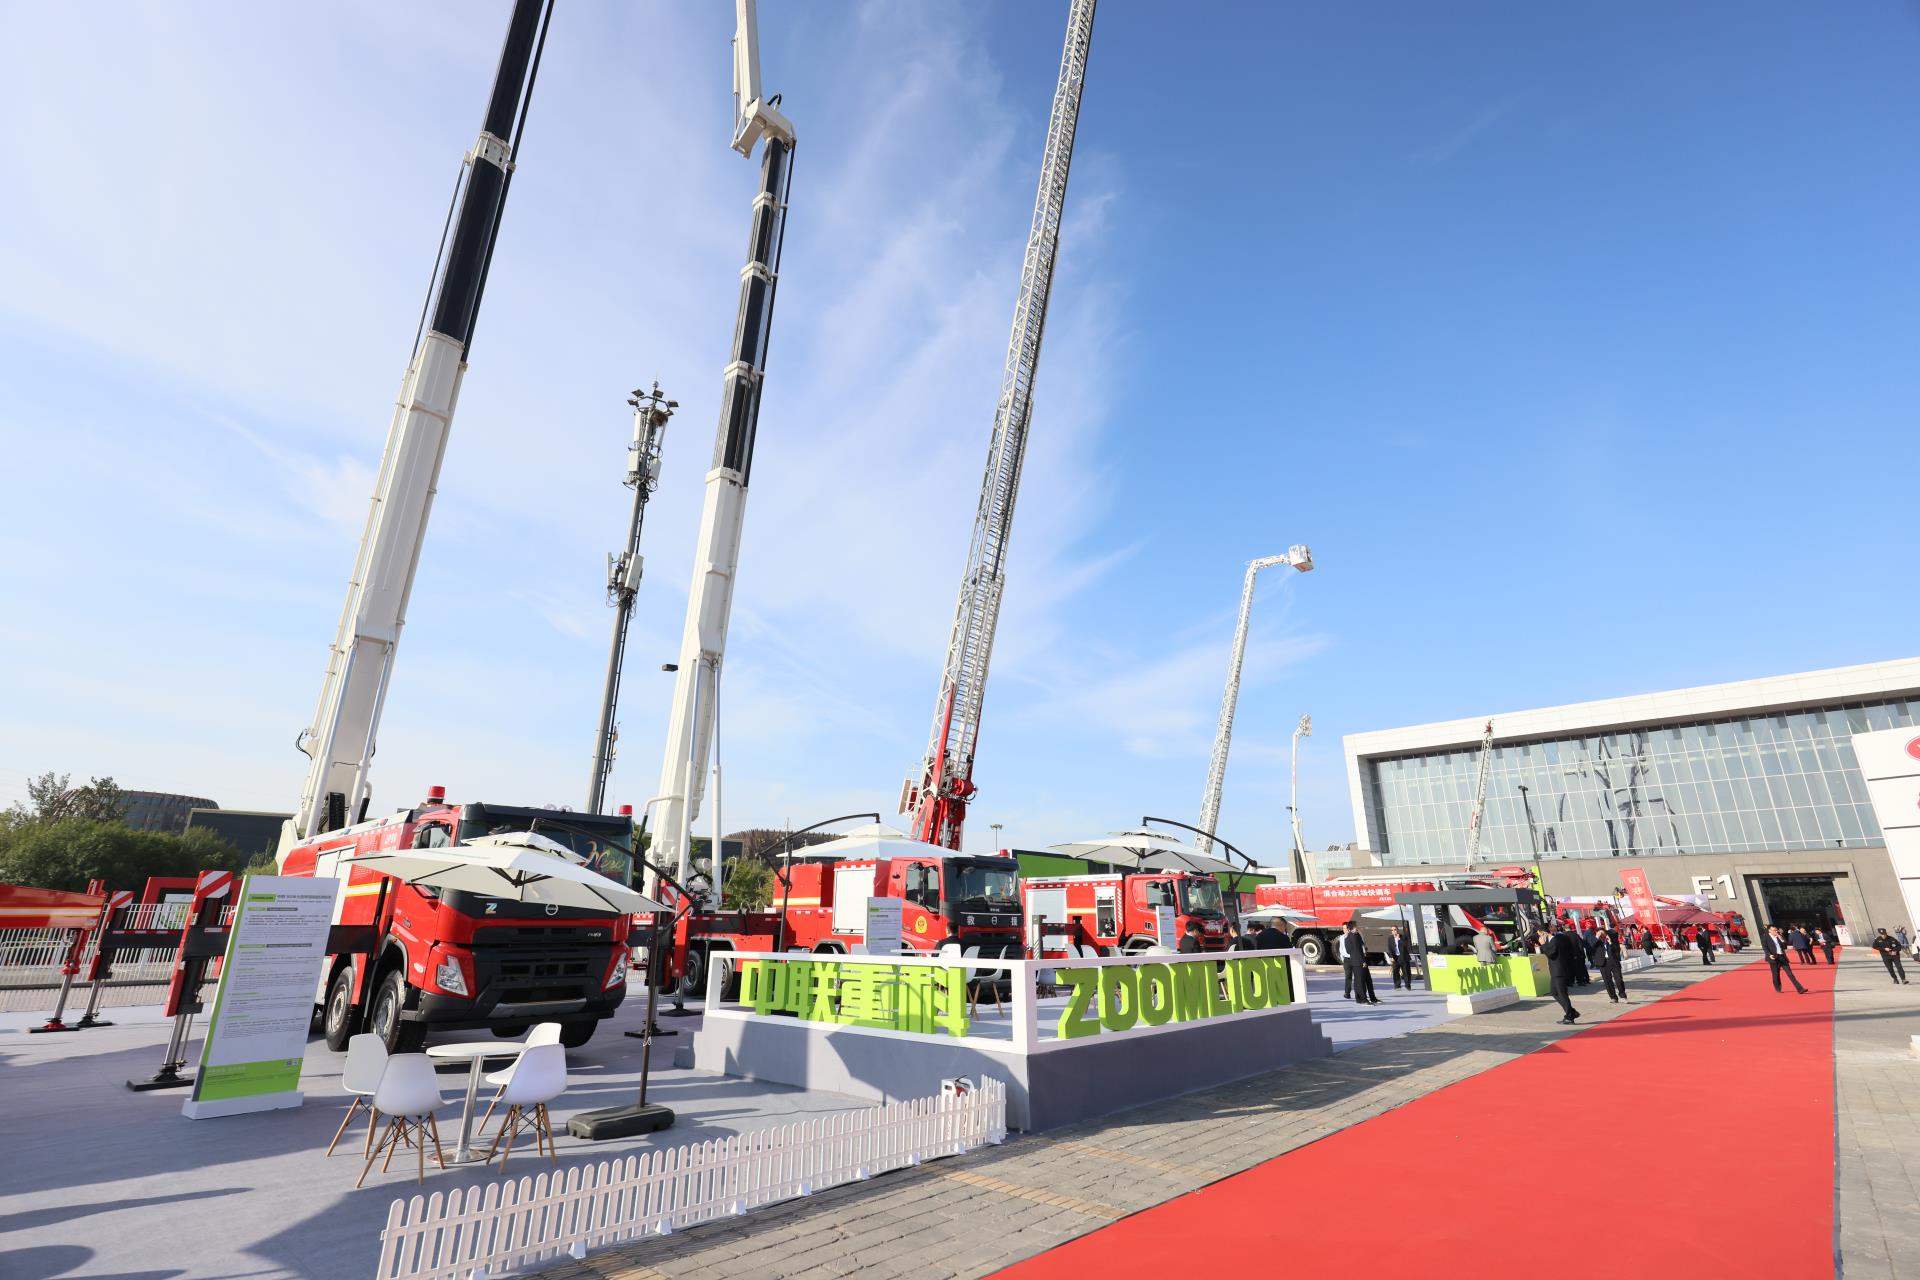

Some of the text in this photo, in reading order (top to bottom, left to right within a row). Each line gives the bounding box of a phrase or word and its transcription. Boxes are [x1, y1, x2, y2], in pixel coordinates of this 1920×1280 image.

[1691, 874, 1738, 900] E1
[739, 959, 971, 1038] 中联重科
[1055, 955, 1293, 1041] ZOOMLION
[1457, 963, 1507, 995] ZOOMLION
